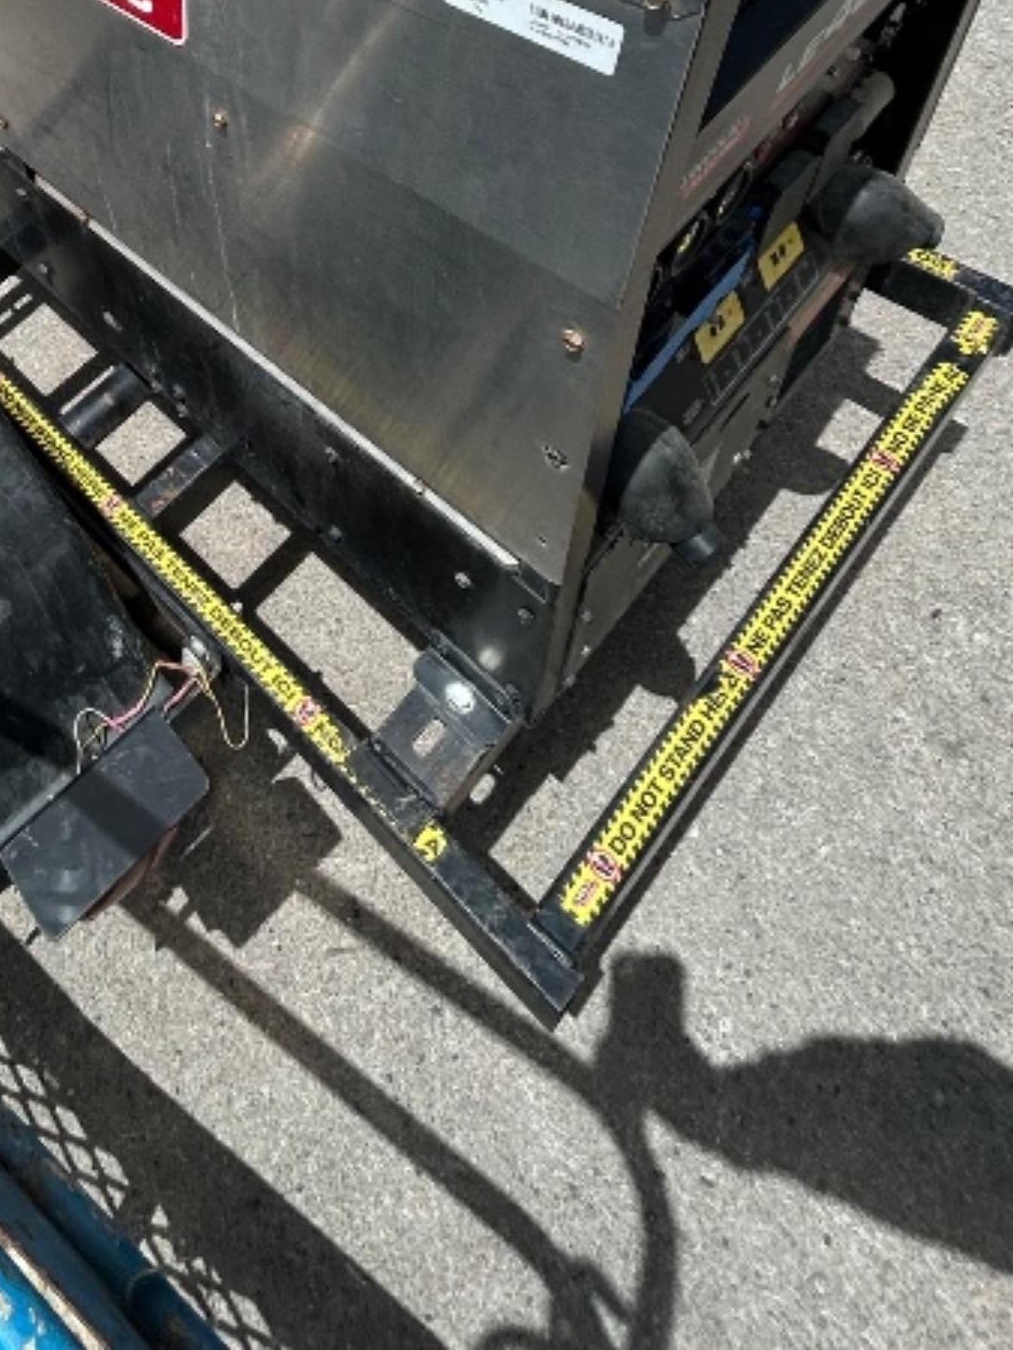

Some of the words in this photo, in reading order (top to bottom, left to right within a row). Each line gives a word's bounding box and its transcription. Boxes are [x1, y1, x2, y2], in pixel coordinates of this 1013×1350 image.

[746, 628, 770, 655] NE
[763, 597, 792, 629] PAS
[608, 821, 637, 856] DO
[629, 779, 664, 823] NOT
[658, 718, 706, 782] STAND
